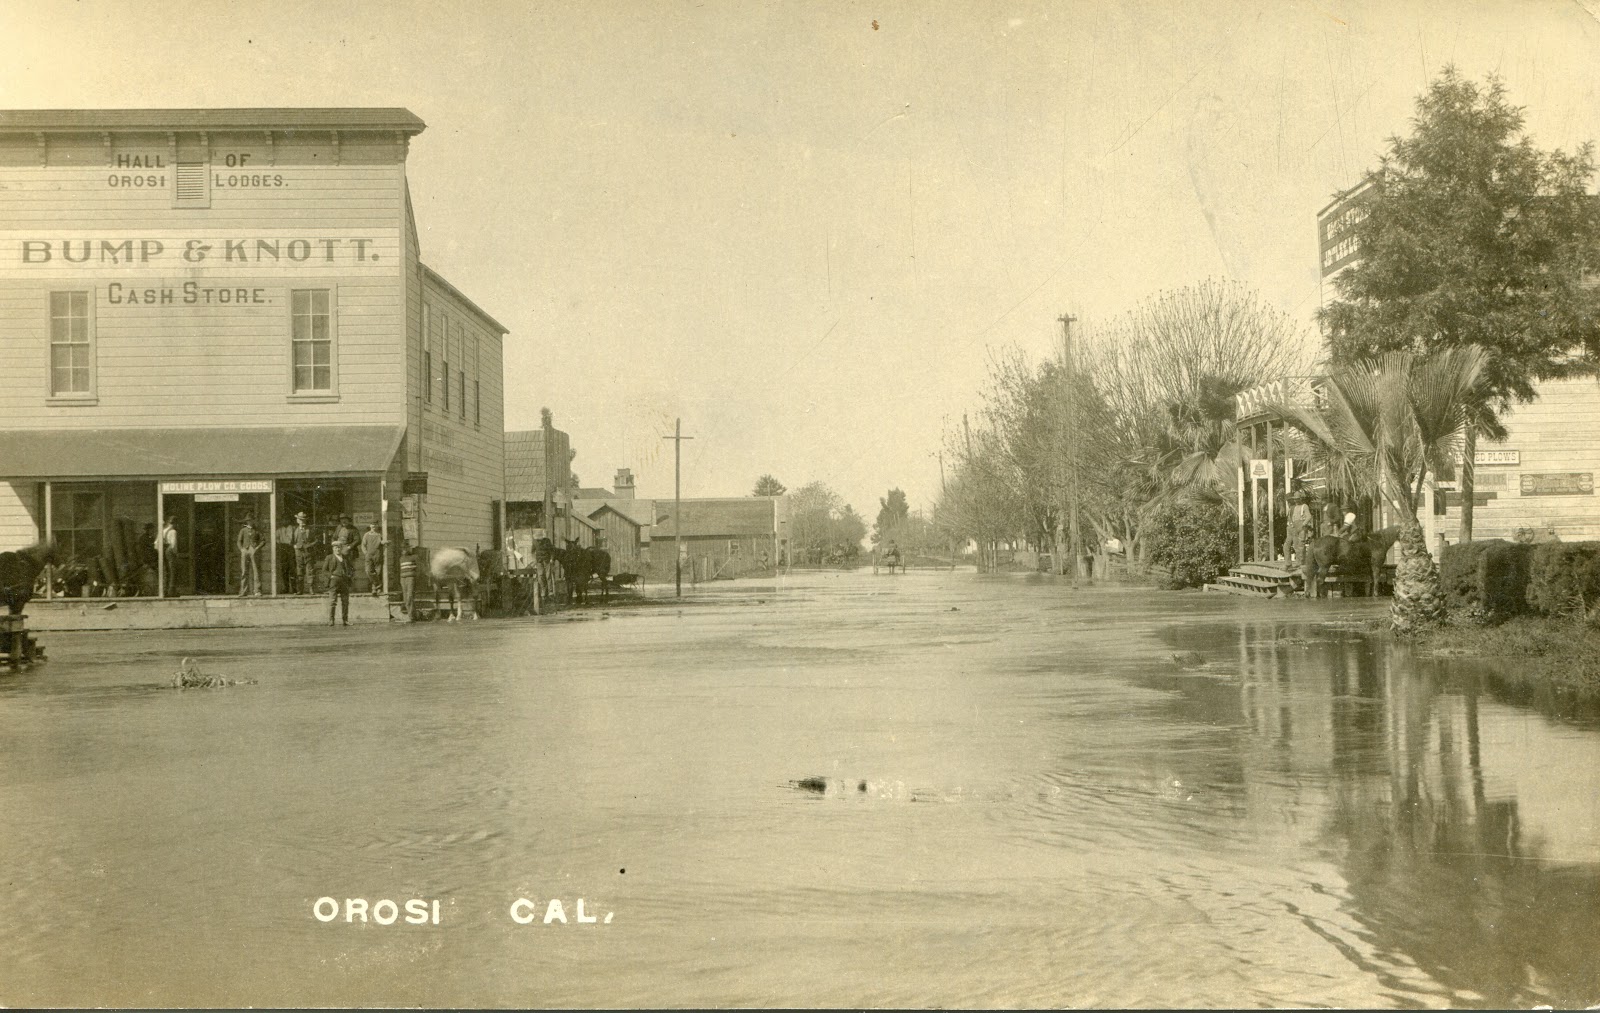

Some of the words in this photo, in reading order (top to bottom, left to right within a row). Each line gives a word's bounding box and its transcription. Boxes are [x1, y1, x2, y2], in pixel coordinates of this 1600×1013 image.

[117, 154, 166, 168] HALL
[225, 153, 252, 167] OF
[107, 175, 165, 188] OROSI
[215, 174, 289, 188] LODGES.
[21, 240, 164, 264] BUMP
[183, 240, 212, 263] &
[224, 238, 381, 262] KNOTT.
[108, 282, 174, 305] CASH
[182, 281, 272, 304] STORE.
[1488, 452, 1516, 461] PLOWS
[162, 482, 195, 492] MOLINE
[197, 482, 221, 491] PLOW
